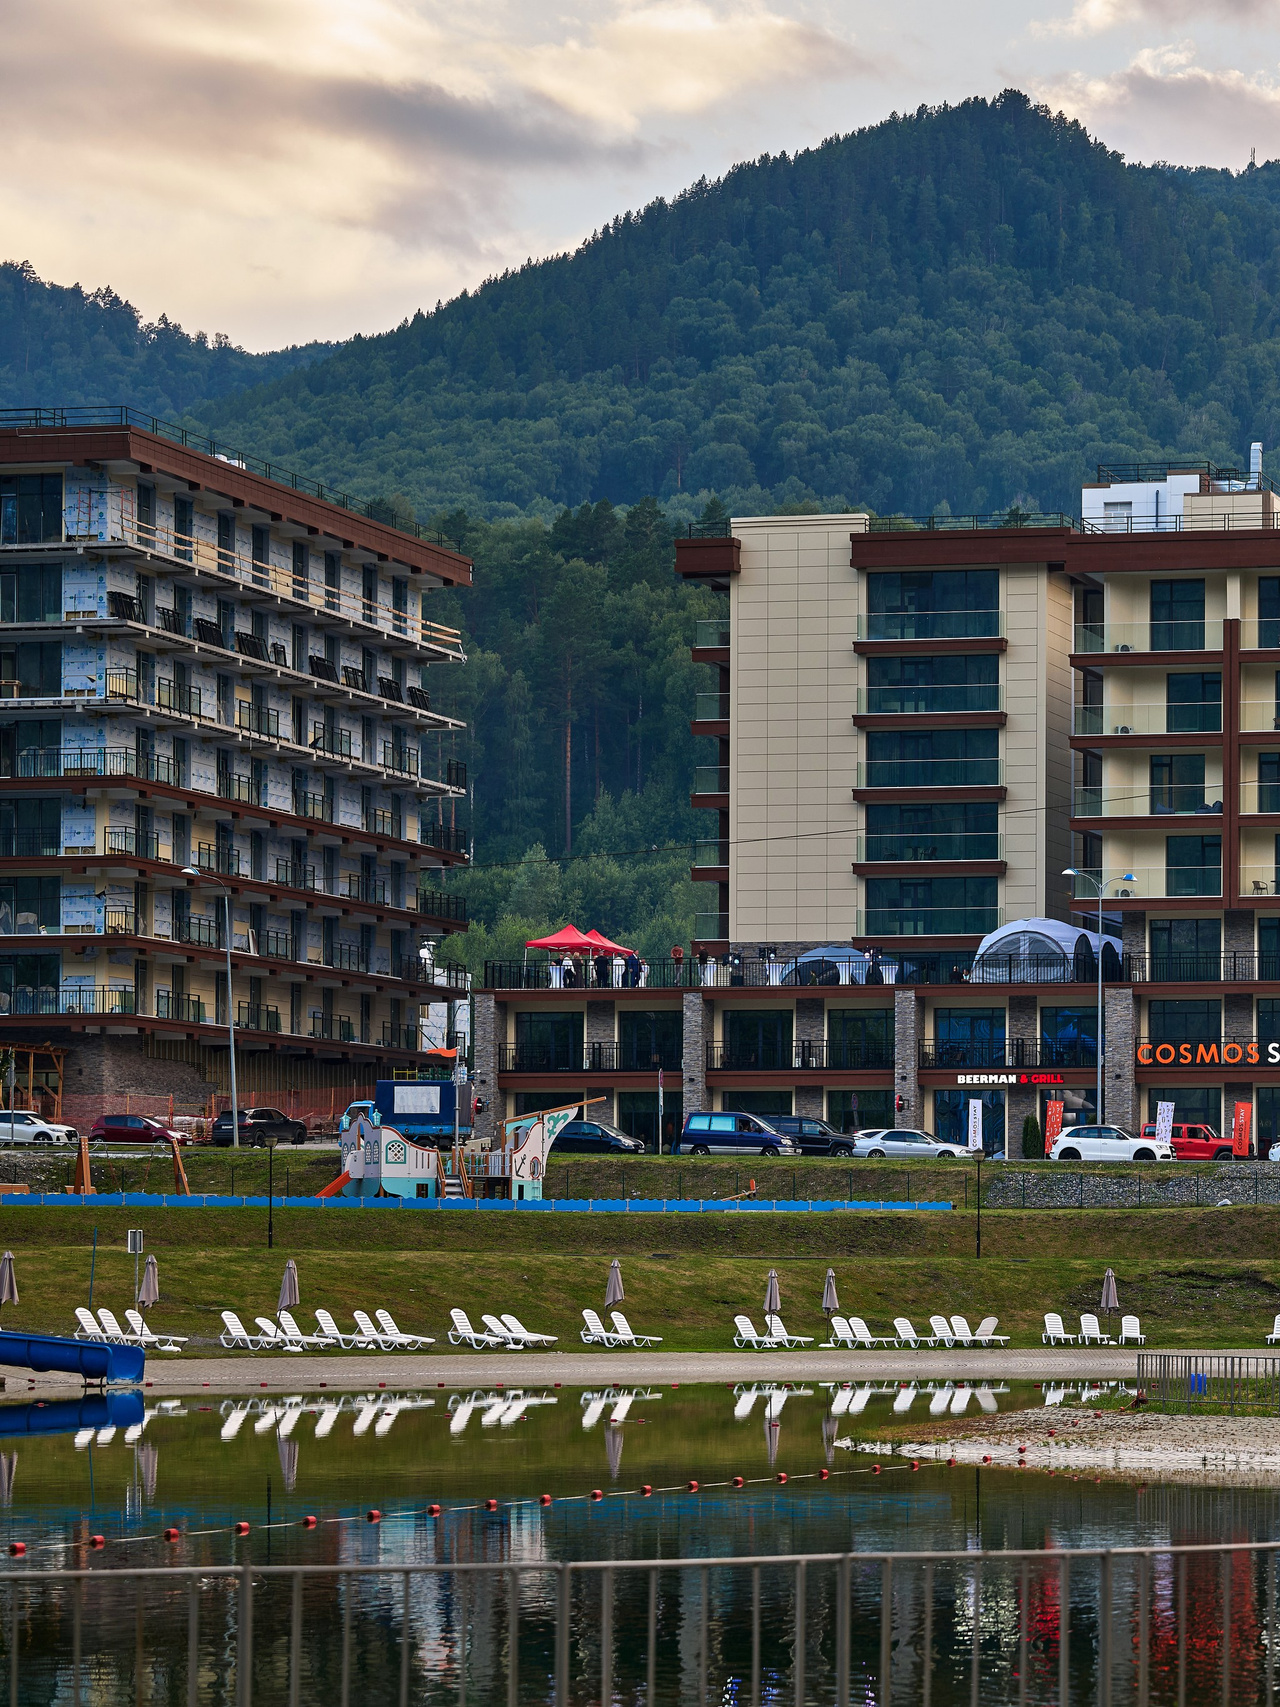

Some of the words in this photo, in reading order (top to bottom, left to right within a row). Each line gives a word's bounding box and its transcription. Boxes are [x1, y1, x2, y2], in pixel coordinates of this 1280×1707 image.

[1137, 1043, 1260, 1064] COSMOS
[957, 1074, 1017, 1084] BEERMAN
[1020, 1074, 1028, 1084] &
[1031, 1074, 1064, 1084] GRILL
